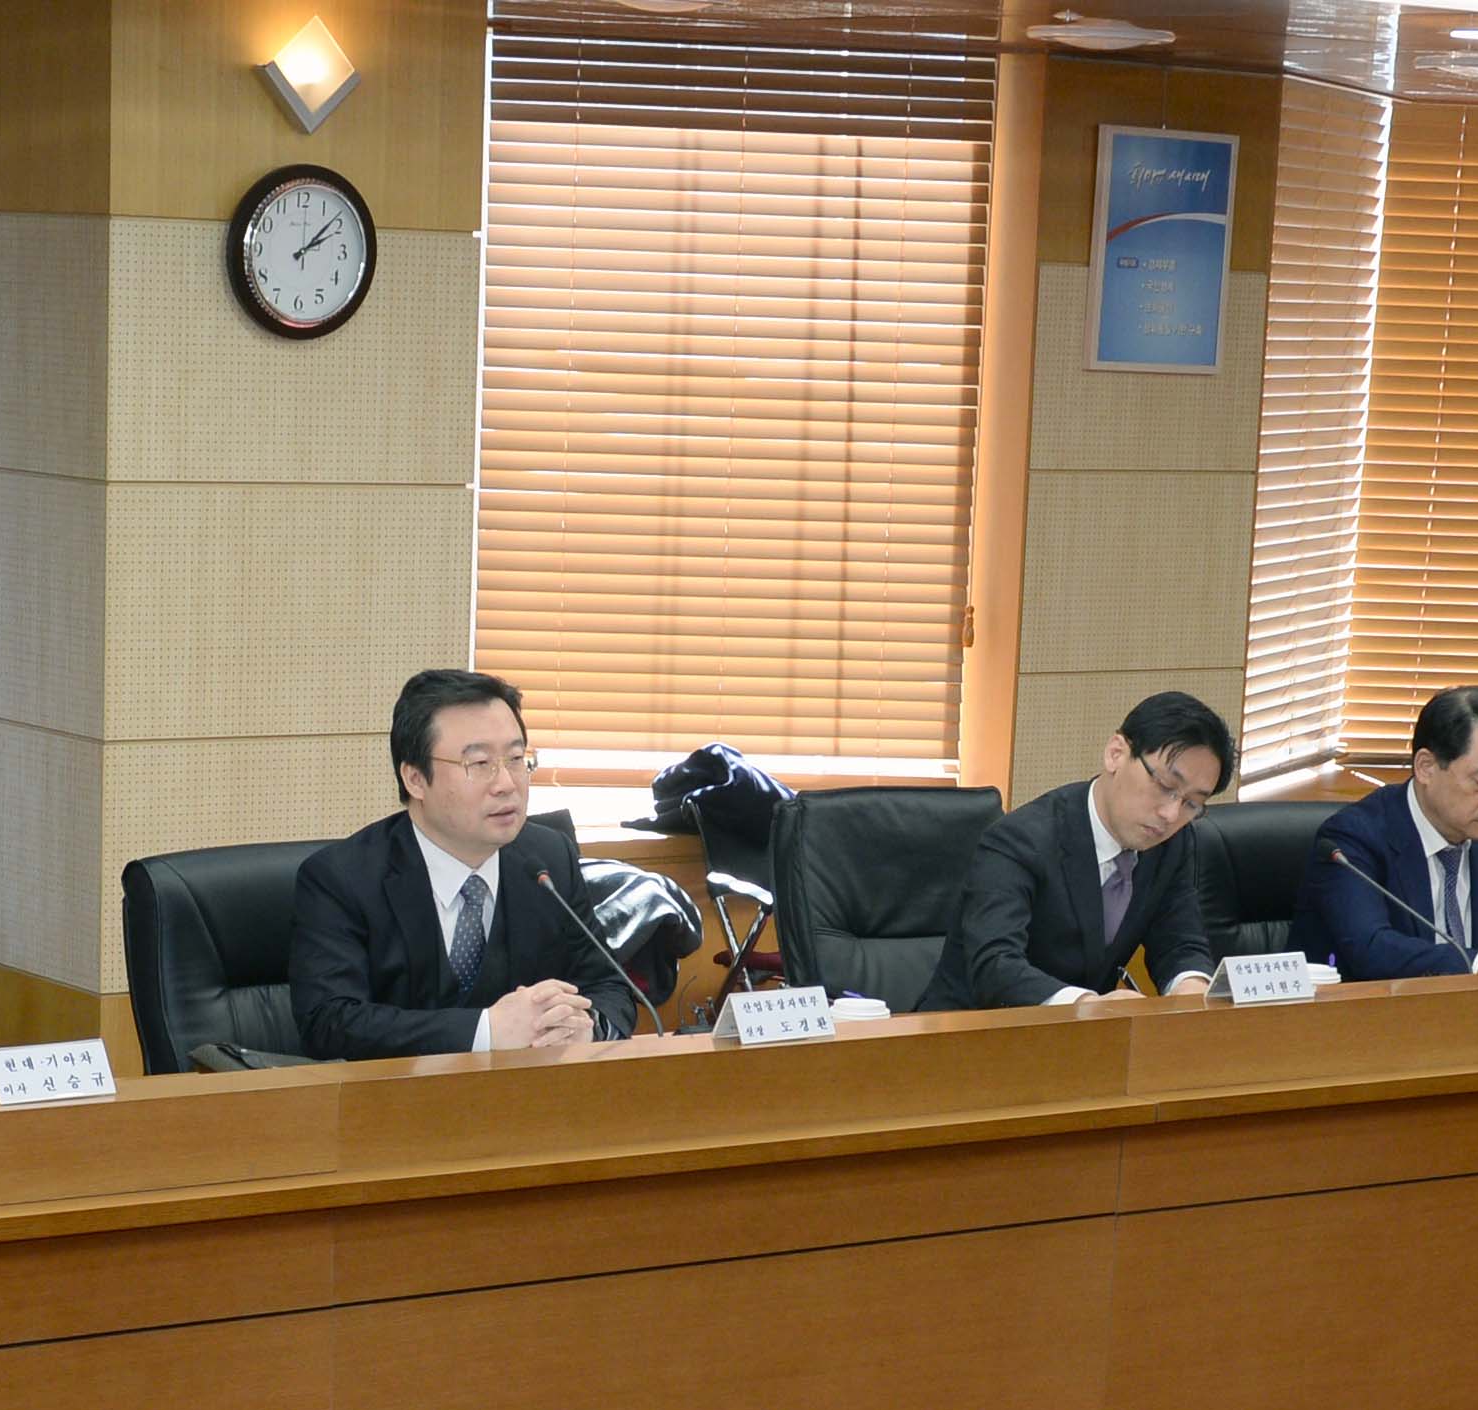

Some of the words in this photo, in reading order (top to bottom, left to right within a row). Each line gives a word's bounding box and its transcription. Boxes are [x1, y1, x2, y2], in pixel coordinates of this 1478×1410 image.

[276, 198, 287, 215] 11
[297, 191, 311, 208] 12
[322, 200, 326, 216] 1
[333, 218, 343, 235] 2
[337, 244, 348, 261] 3
[257, 267, 268, 286] 8
[330, 268, 341, 285] 4
[272, 287, 281, 305] 7
[293, 295, 303, 311] 6
[314, 288, 324, 305] 5
[3, 1082, 27, 1096] 이사
